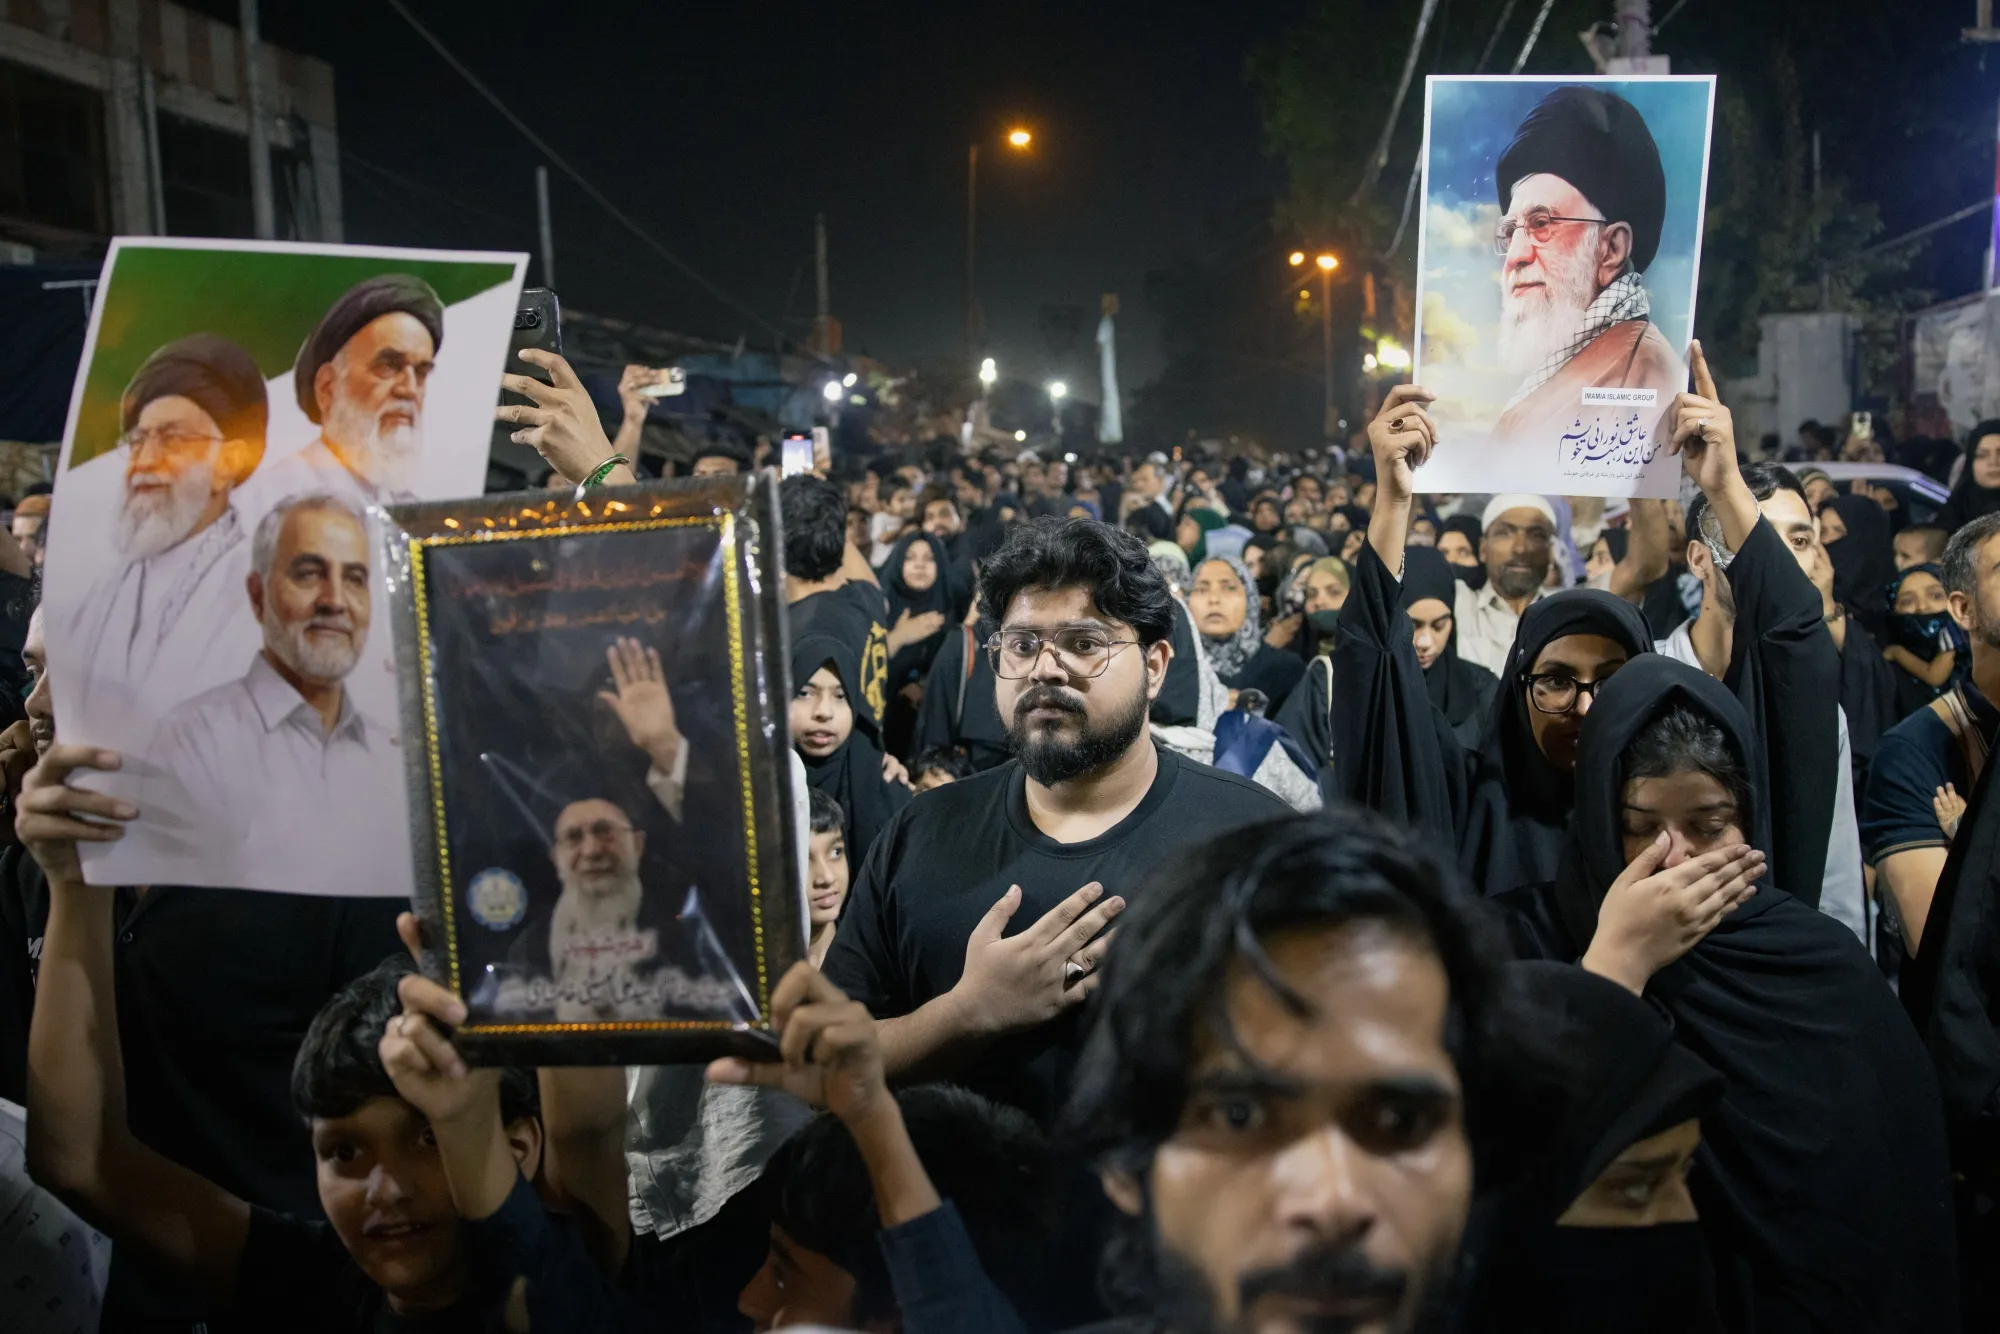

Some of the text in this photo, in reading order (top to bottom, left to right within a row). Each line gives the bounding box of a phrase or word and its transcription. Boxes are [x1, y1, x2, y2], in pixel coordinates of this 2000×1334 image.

[1584, 392, 1655, 401] IMAMIA ISLAMIC GROUP
